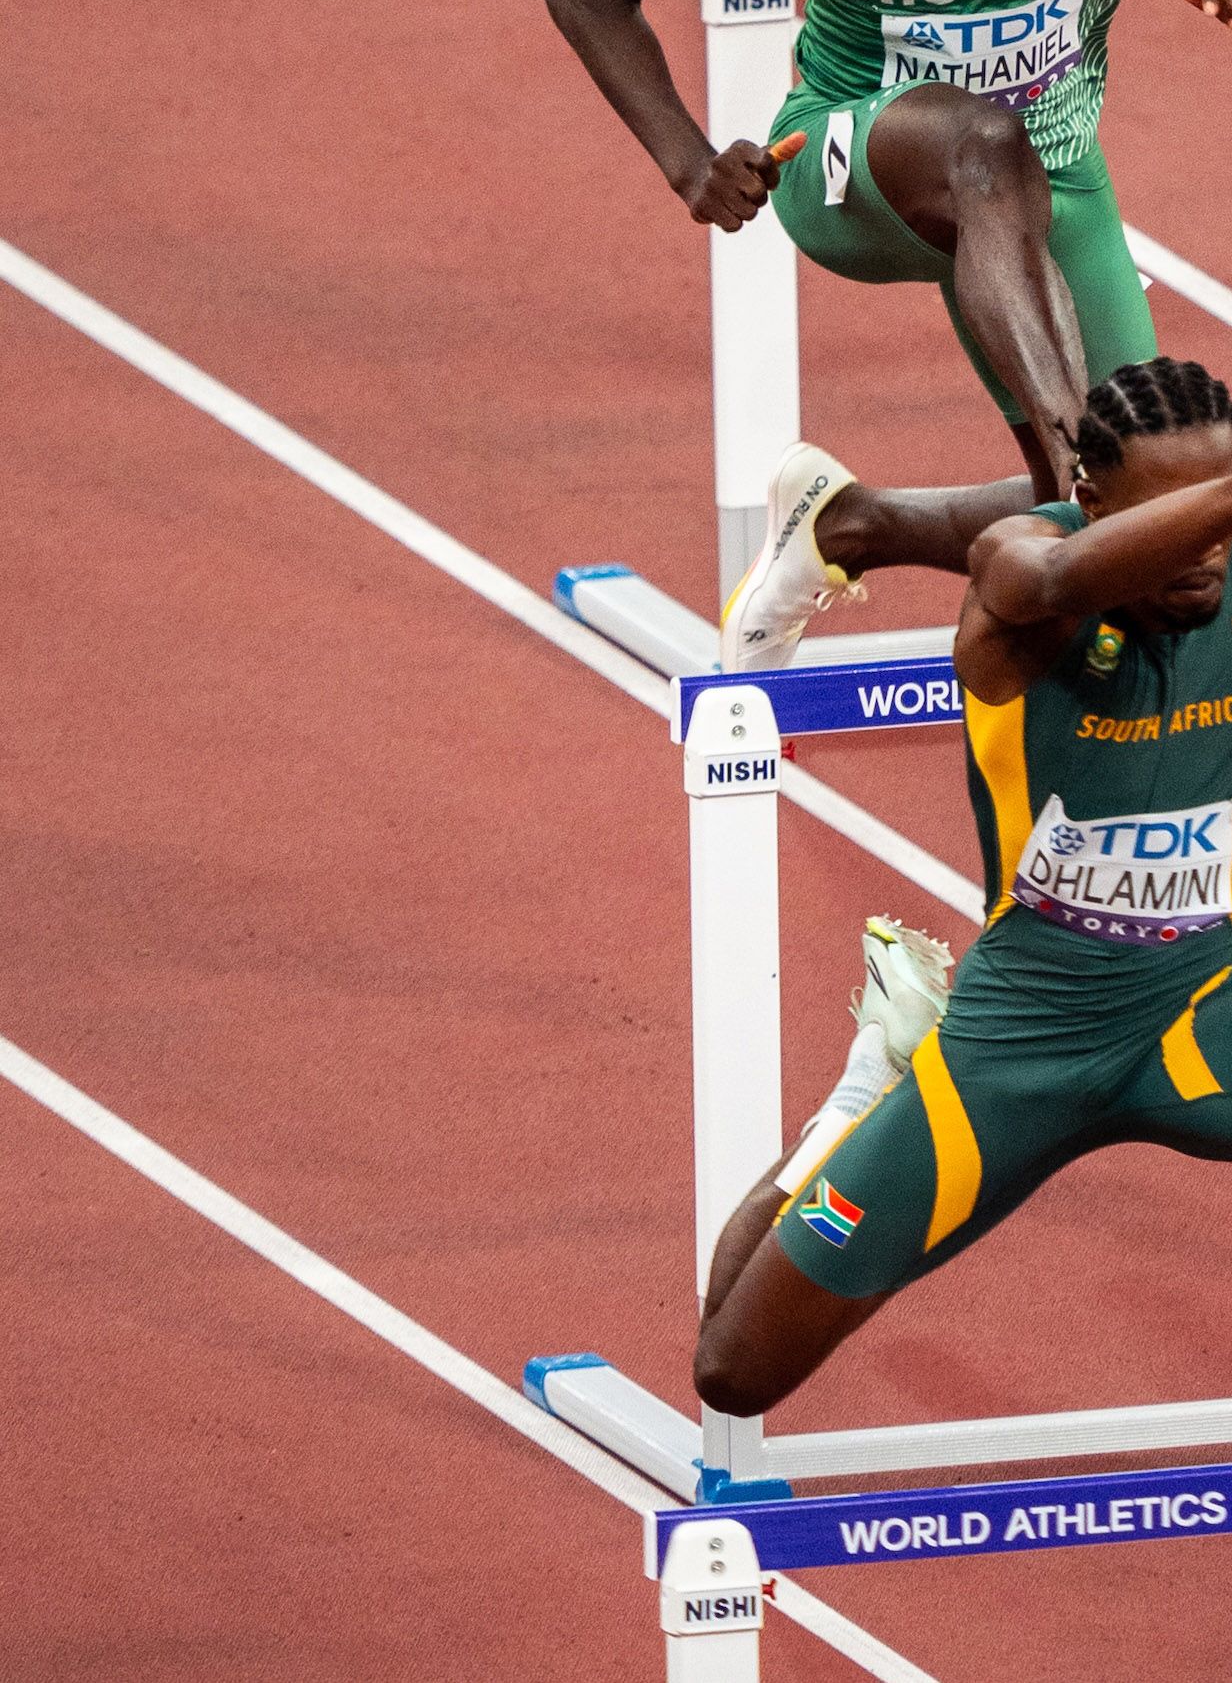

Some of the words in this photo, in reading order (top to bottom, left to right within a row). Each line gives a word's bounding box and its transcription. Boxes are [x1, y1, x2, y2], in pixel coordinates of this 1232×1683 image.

[895, 25, 1072, 90] NATHANIEL
[806, 475, 828, 501] ON
[858, 679, 963, 718] WORL
[1076, 713, 1161, 743] SOUTH
[707, 759, 776, 784] NISHI
[1090, 812, 1222, 860] TDK
[1028, 848, 1223, 911] DHLAMINI
[839, 1511, 991, 1555] WORLD
[1004, 1491, 1228, 1542] ATHLETICS
[685, 1594, 757, 1622] NISHI
